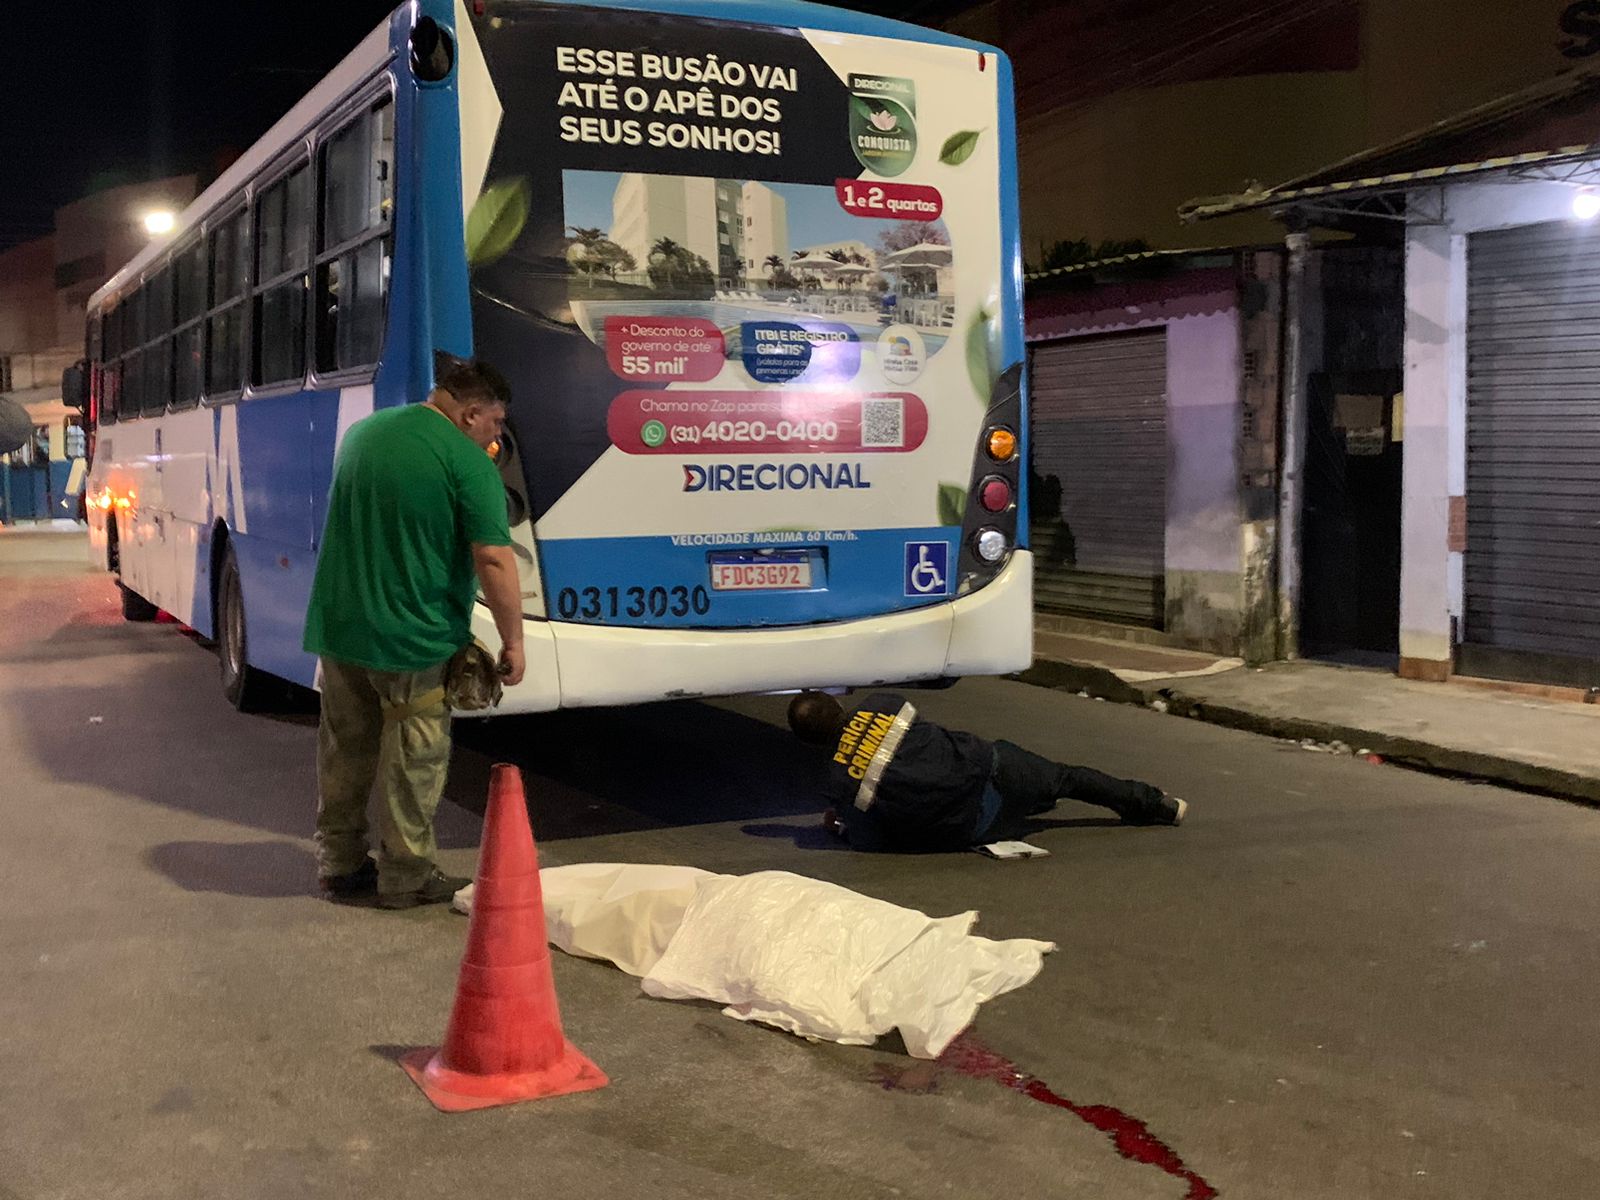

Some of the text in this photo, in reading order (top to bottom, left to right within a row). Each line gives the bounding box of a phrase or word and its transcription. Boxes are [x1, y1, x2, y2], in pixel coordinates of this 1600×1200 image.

[556, 46, 798, 92] ESSE BUSÃO VAI
[557, 78, 781, 123] ATÉ O APÊ DOS
[560, 116, 782, 156] SEUS SONHOS!
[858, 135, 911, 151] CONQUISTA
[844, 186, 938, 213] 1 e 2 quartos
[630, 324, 687, 338] Desconto
[689, 325, 705, 338] do
[754, 329, 848, 343] ITBI E REGISTRO
[621, 341, 711, 354] governo de até
[621, 356, 652, 374] 55
[755, 367, 789, 376] primeiras
[783, 358, 800, 367] para
[639, 397, 689, 413] Chama
[691, 402, 708, 413] no
[709, 399, 736, 414] Zap
[738, 402, 768, 415] para
[670, 421, 837, 445] (31) 4020-0400
[682, 463, 871, 492] DIRECIONAL
[671, 531, 751, 547] VELOCIDADE
[753, 531, 804, 544] MAXIMA
[806, 531, 822, 543] 60
[719, 565, 801, 586] FDC3G92
[557, 584, 709, 619] 0313030
[833, 710, 874, 765] PERÍCIA
[848, 713, 896, 780] CRIMINAL
